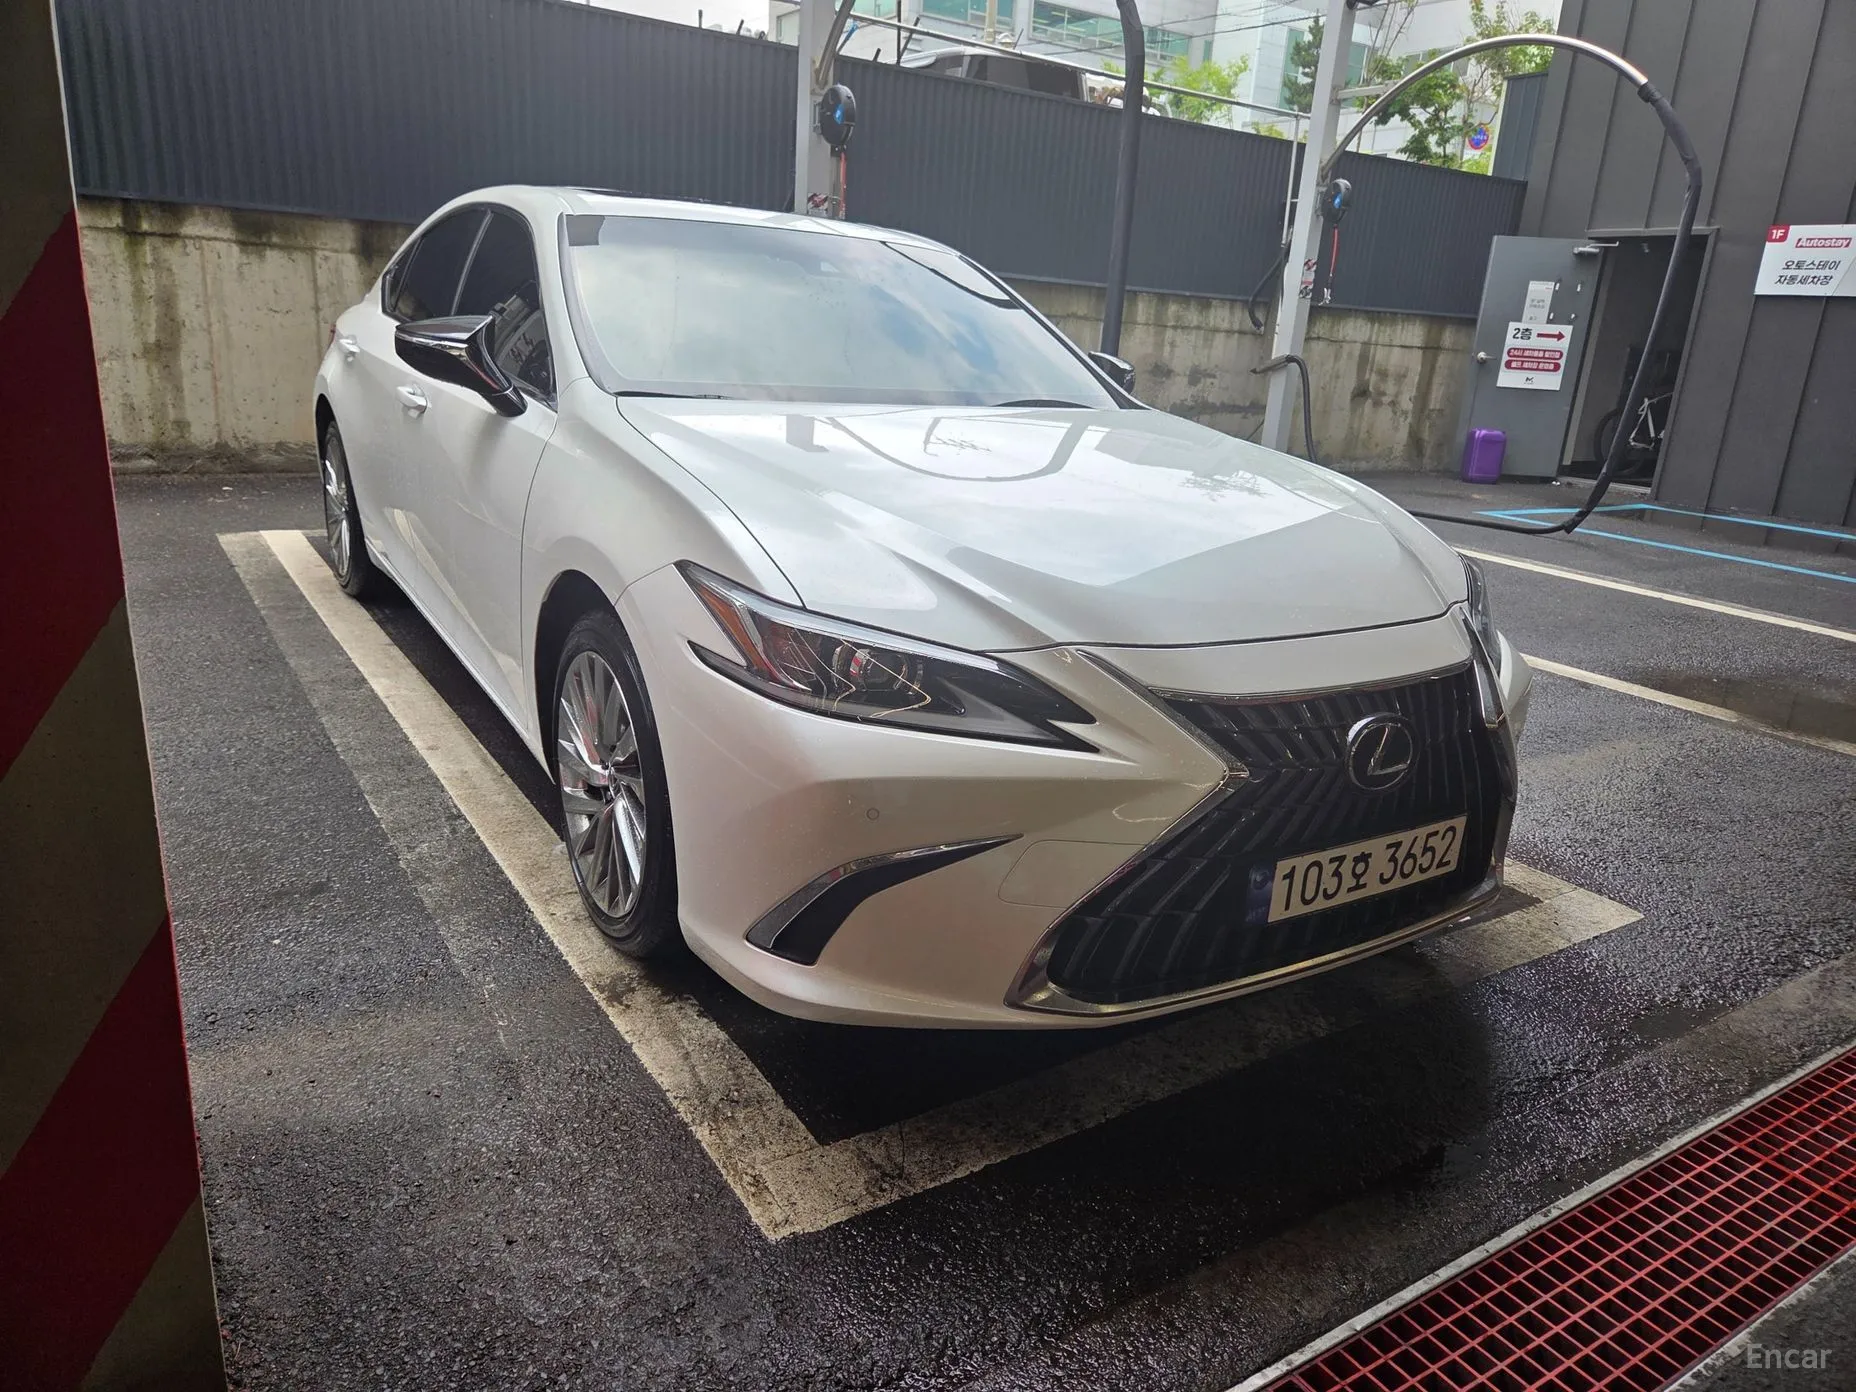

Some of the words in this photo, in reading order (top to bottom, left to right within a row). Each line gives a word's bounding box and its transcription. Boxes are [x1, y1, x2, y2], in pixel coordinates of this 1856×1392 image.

[1771, 229, 1785, 239] 1F
[1797, 238, 1850, 248] Autostay
[1782, 260, 1841, 270] 오토스테이
[1775, 275, 1833, 285] 자동세차장
[1512, 327, 1532, 340] 2층
[1282, 851, 1372, 911] 103호
[1379, 825, 1456, 885] 3652
